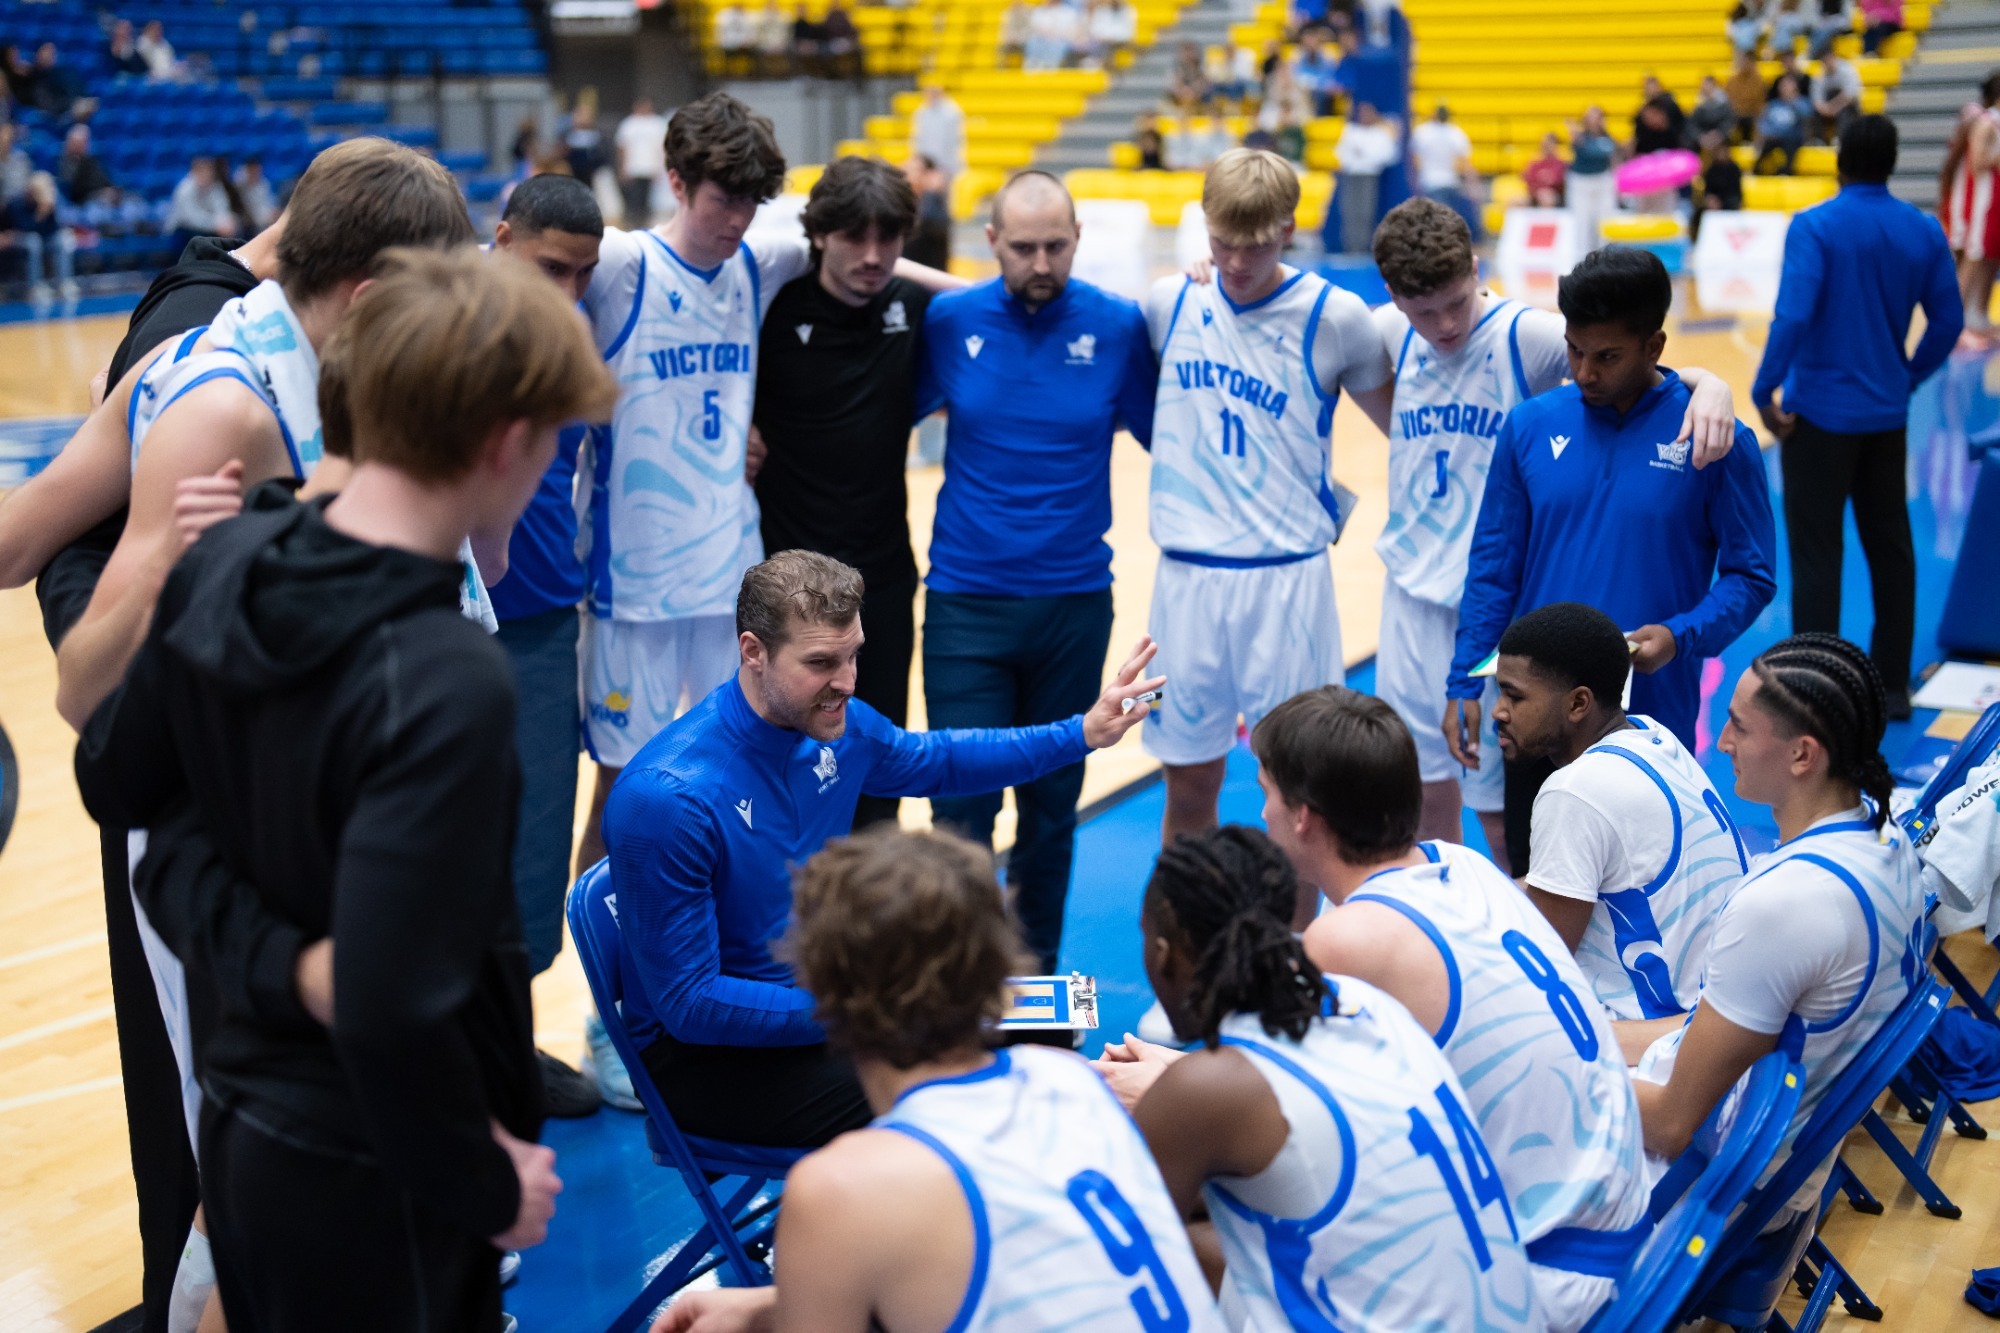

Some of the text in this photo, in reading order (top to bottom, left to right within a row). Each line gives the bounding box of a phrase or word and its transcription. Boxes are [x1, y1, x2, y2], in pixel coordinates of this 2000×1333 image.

[703, 390, 720, 440] 5
[1175, 360, 1288, 419] VICTORIA
[1220, 407, 1245, 457] 11
[1501, 929, 1599, 1062] 8
[1406, 1081, 1519, 1273] 14
[1066, 1169, 1190, 1333] 9
